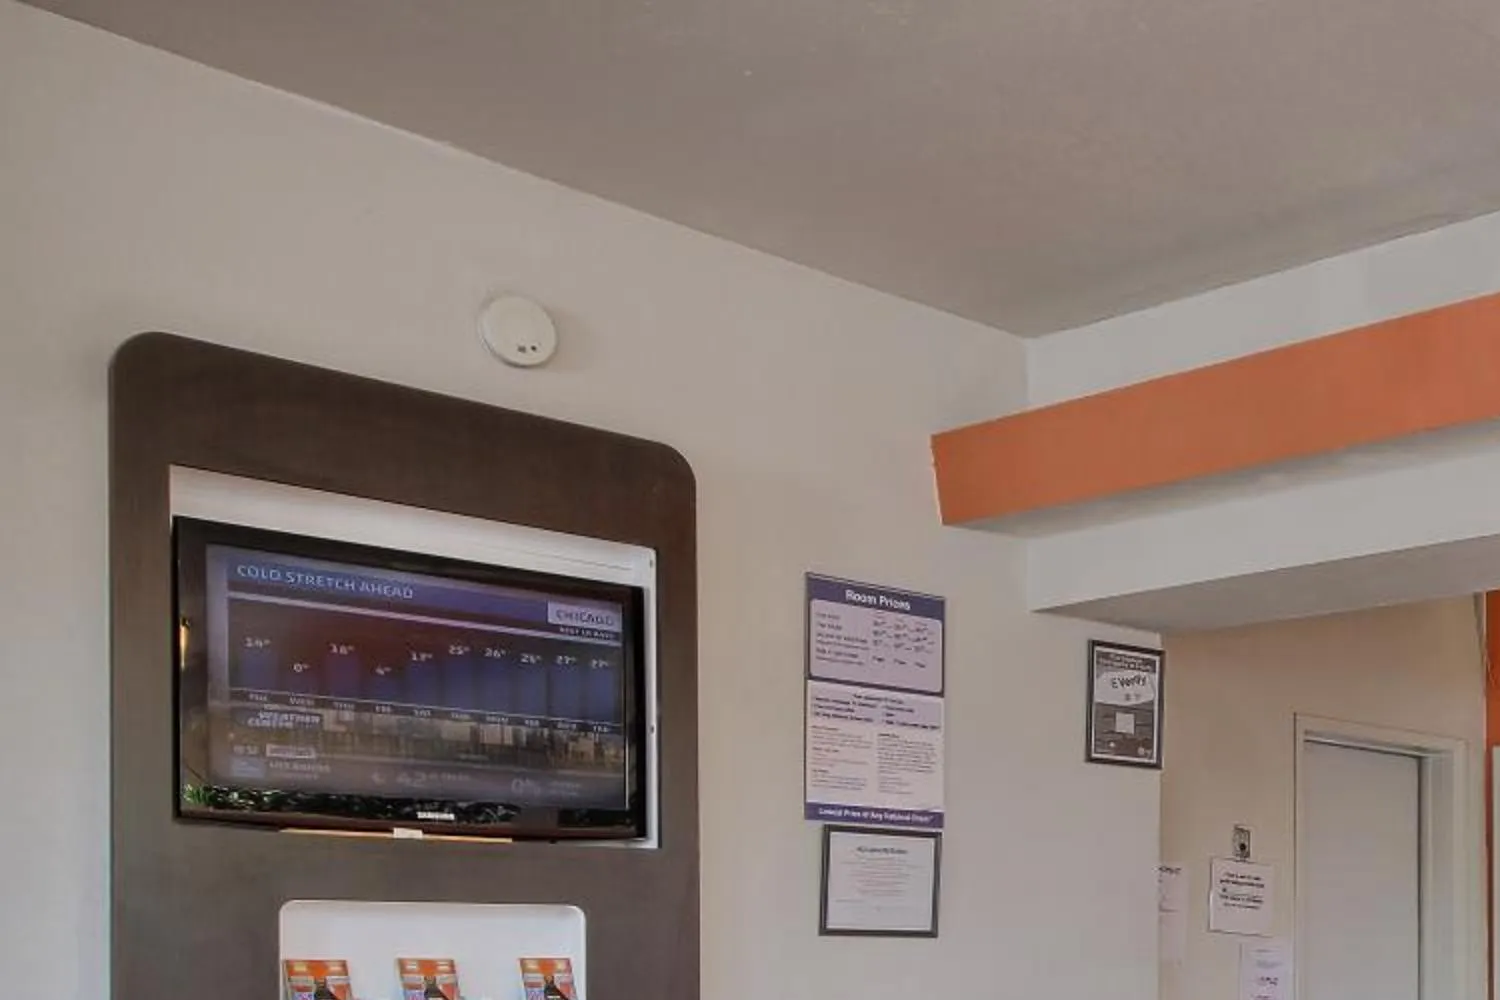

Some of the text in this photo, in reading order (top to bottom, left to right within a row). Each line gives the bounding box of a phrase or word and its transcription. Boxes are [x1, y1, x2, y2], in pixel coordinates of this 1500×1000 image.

[237, 565, 414, 599] COLD STRETCH AHEAD
[844, 588, 911, 611] Room Prices
[556, 608, 615, 627] CHICAGO
